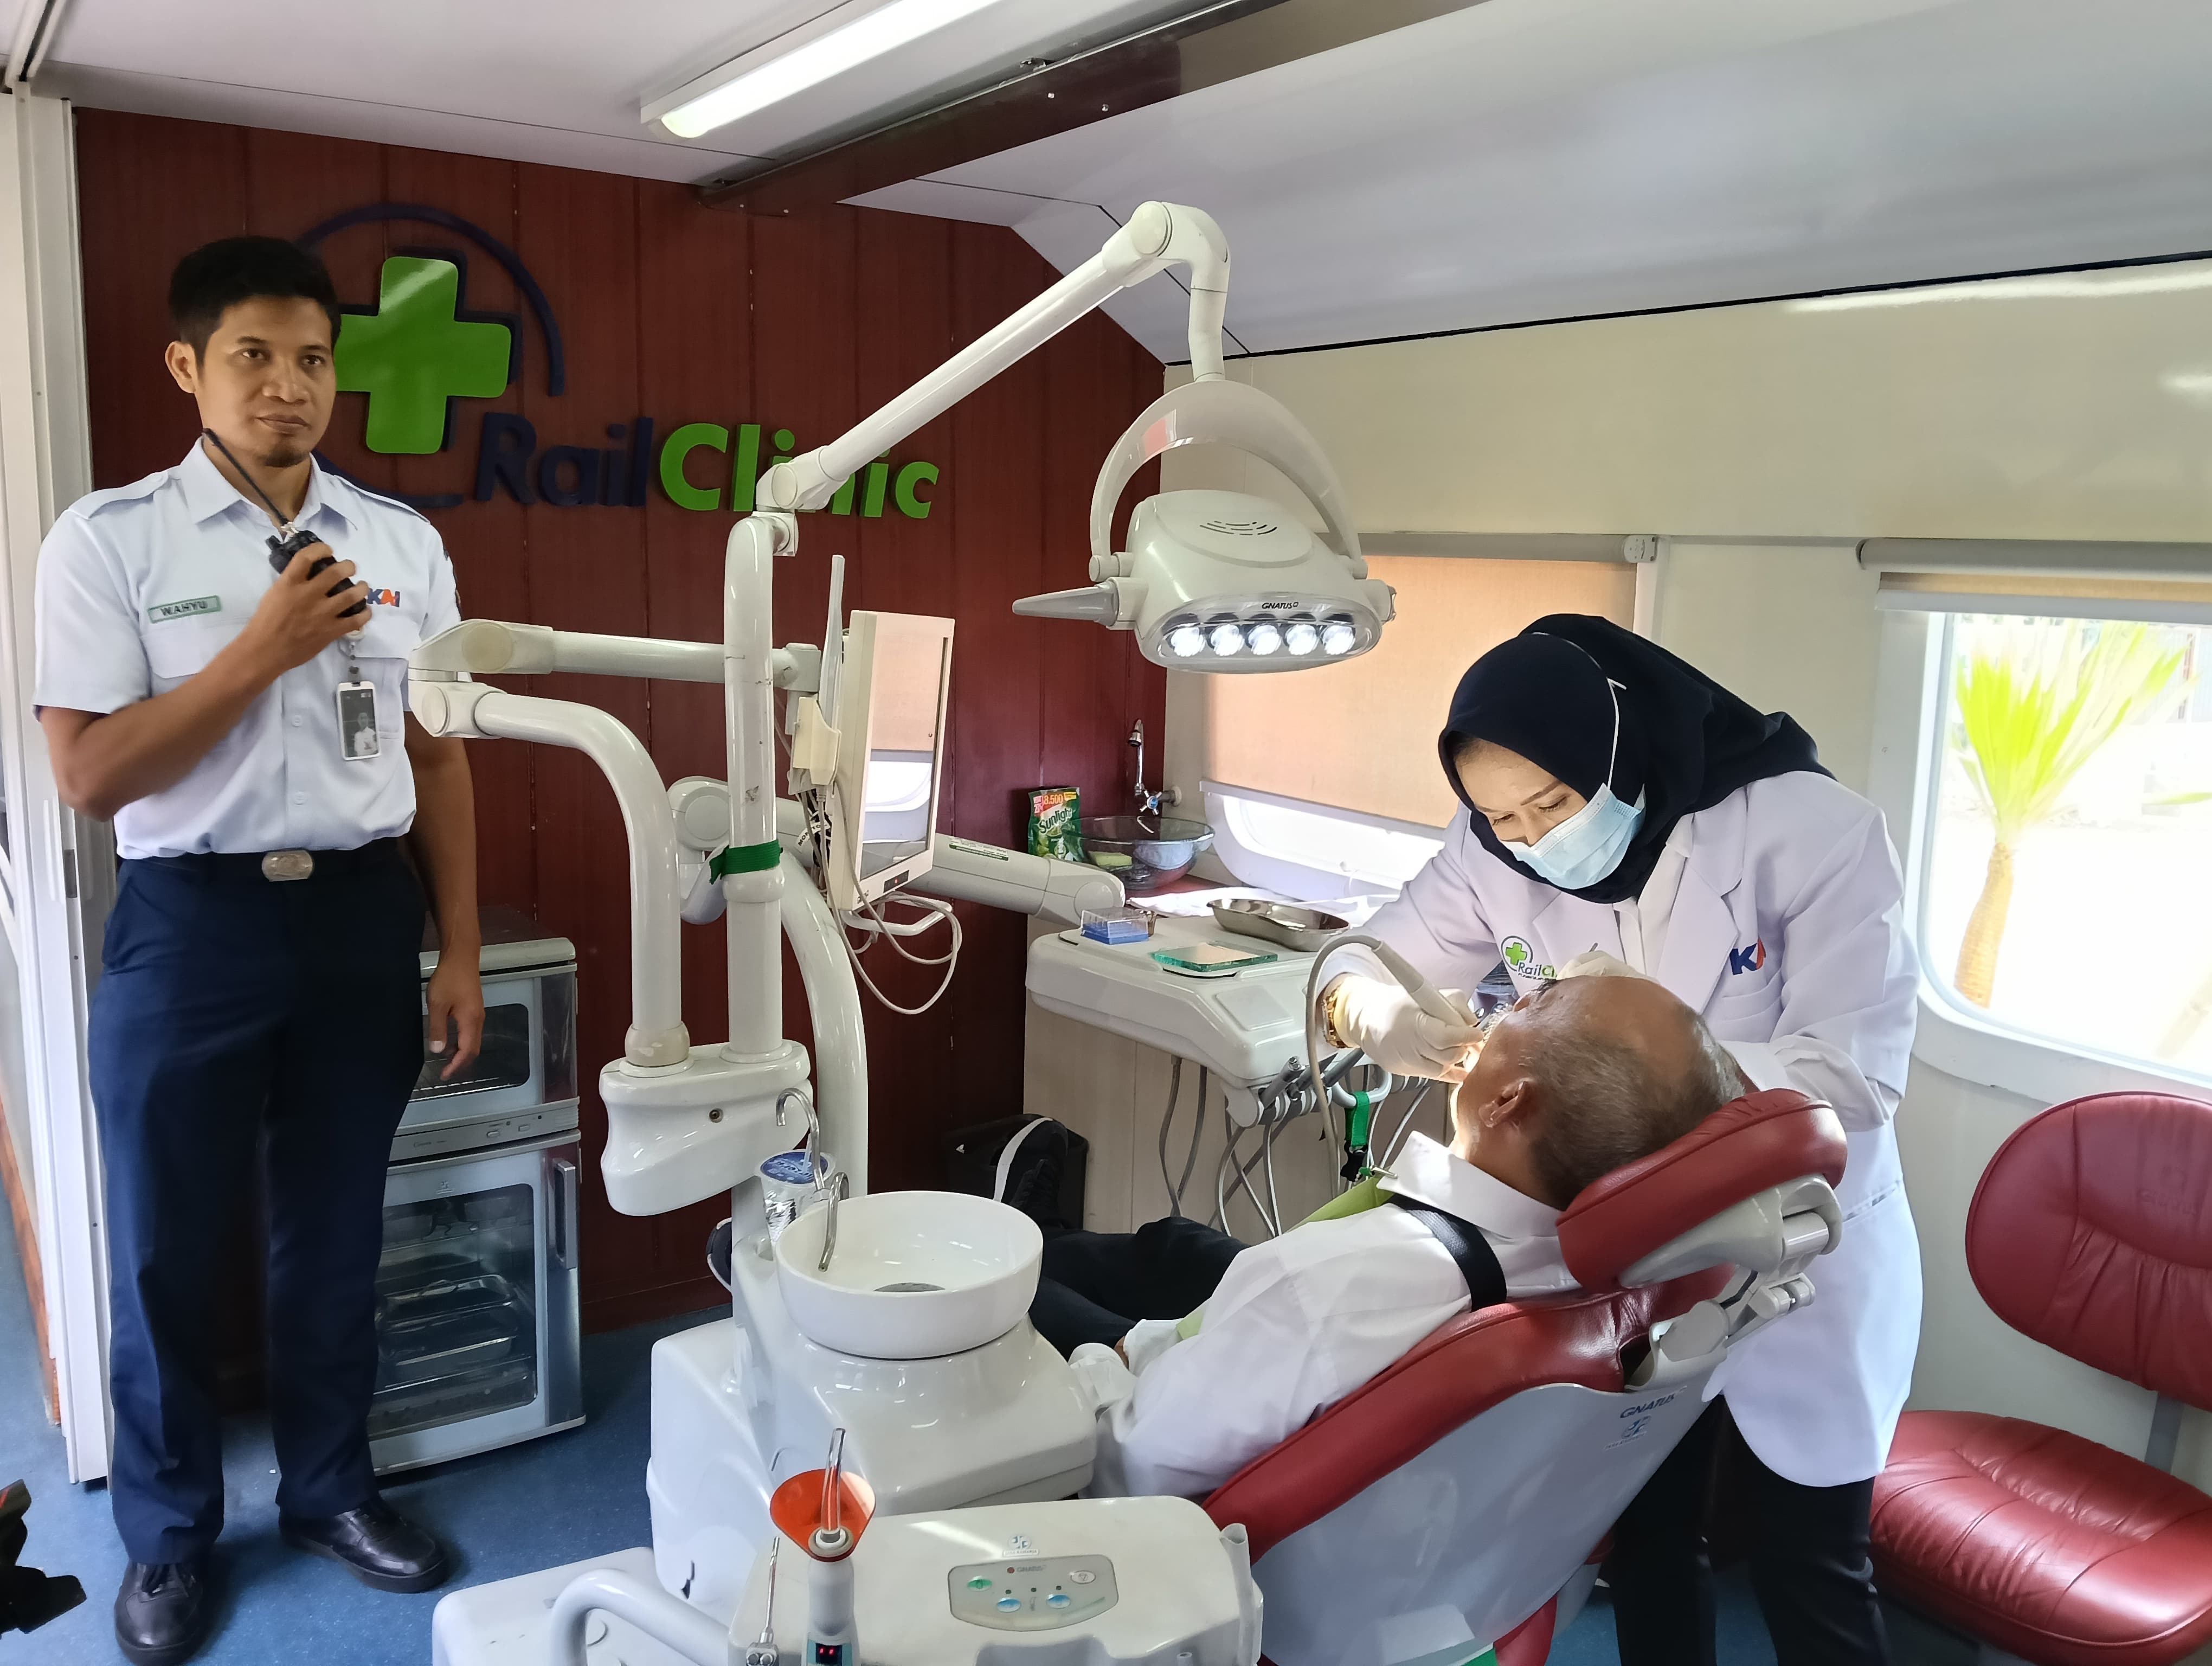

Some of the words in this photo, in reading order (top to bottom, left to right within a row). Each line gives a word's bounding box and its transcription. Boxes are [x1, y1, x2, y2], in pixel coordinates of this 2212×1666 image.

[160, 600, 208, 616] WAHYU
[1043, 793, 1064, 805] 8.500
[1517, 962, 1557, 978] RailCl
[1619, 1393, 1675, 1419] GNATUS
